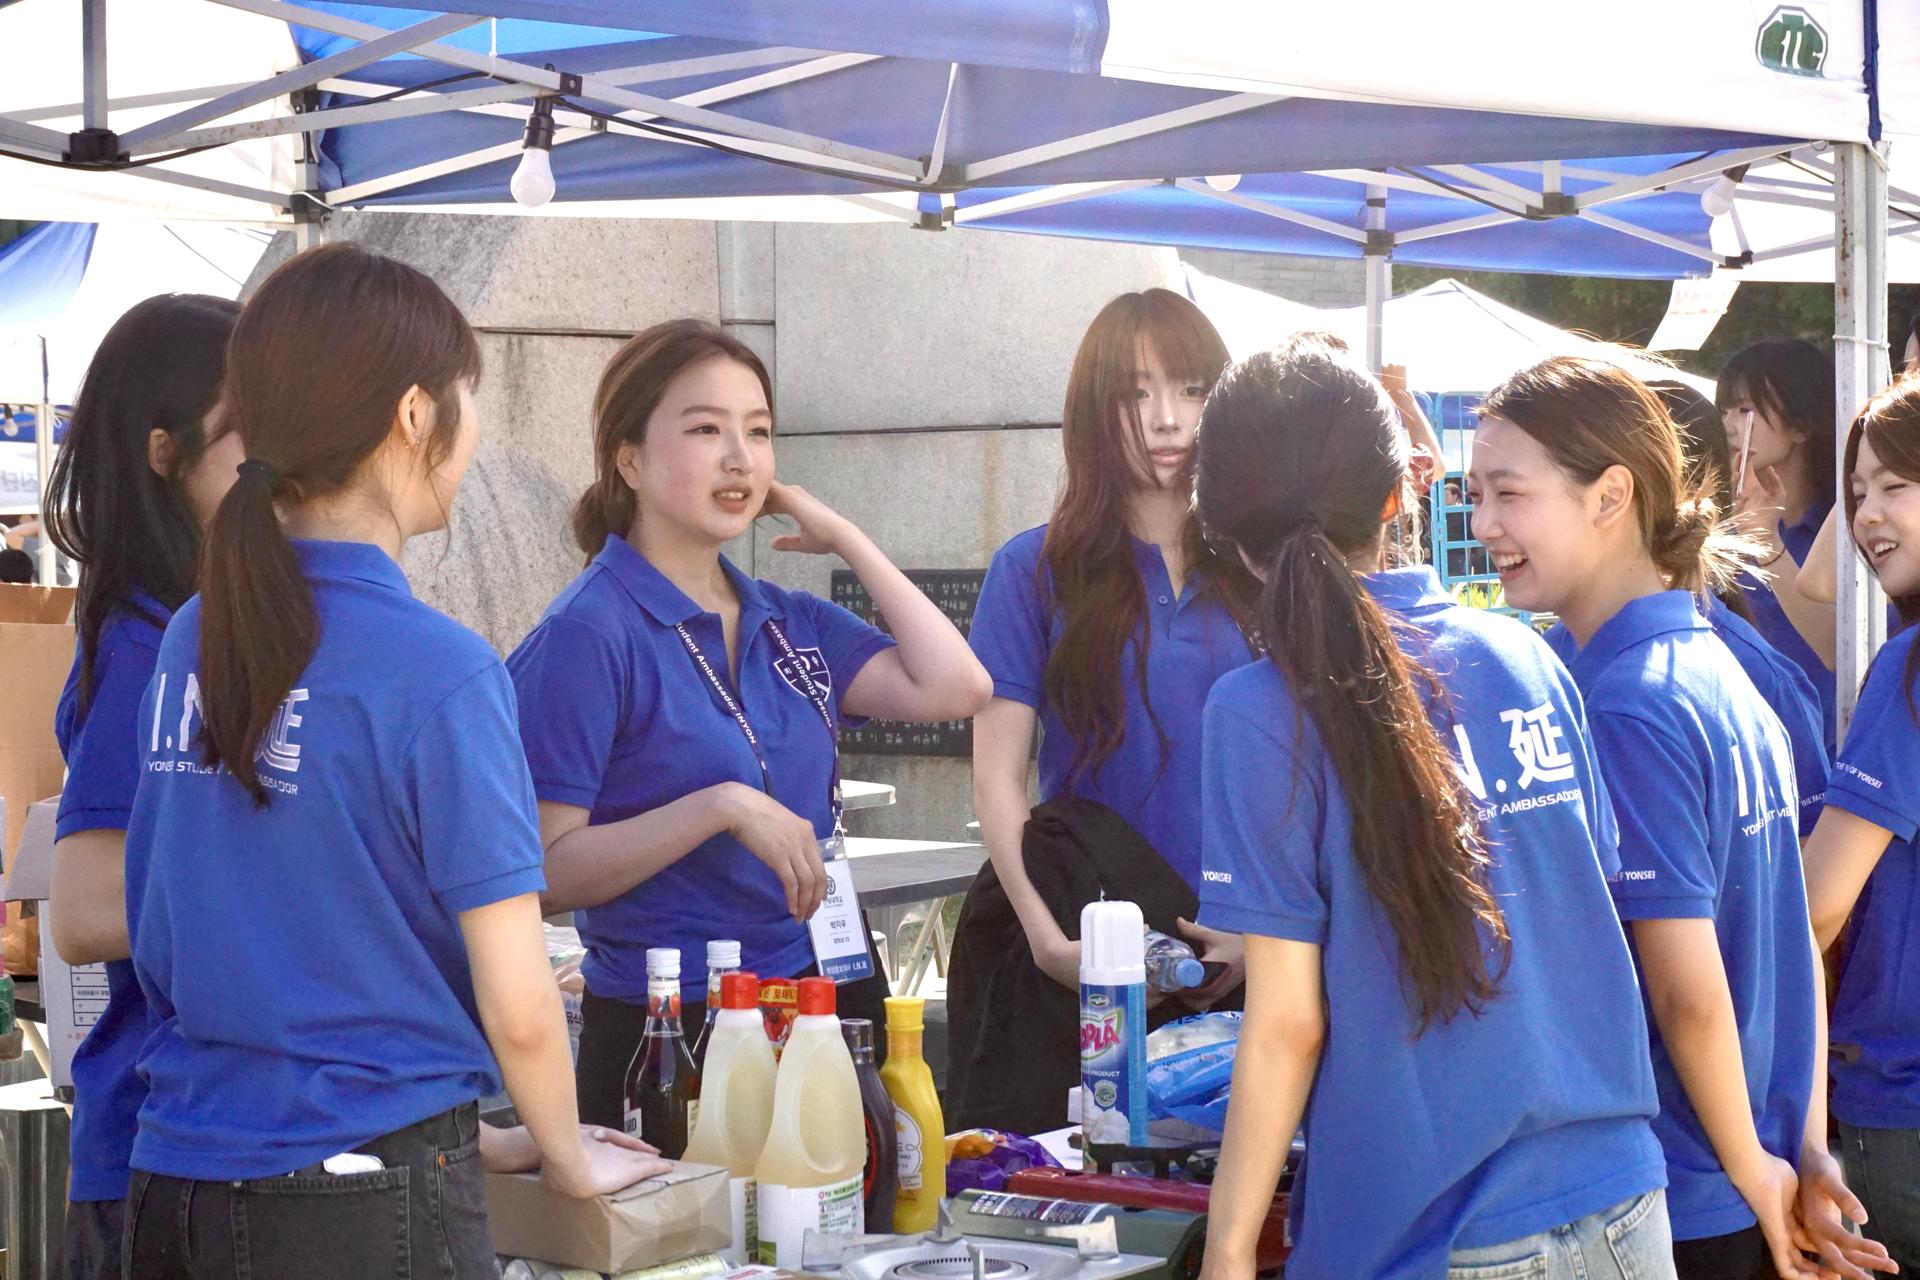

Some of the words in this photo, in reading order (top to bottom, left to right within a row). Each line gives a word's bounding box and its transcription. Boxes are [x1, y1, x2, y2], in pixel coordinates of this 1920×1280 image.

[676, 622, 699, 654] tudent
[696, 655, 737, 711] Ambassador
[735, 713, 756, 744] INYON
[792, 660, 817, 696] Student
[814, 697, 832, 728] Yonsei
[1858, 770, 1883, 789] YONSEI
[1478, 805, 1497, 821] ENT
[1501, 789, 1582, 815] AMBASSADOR
[1202, 870, 1232, 884] YONSEI
[1625, 870, 1656, 881] YONSEI
